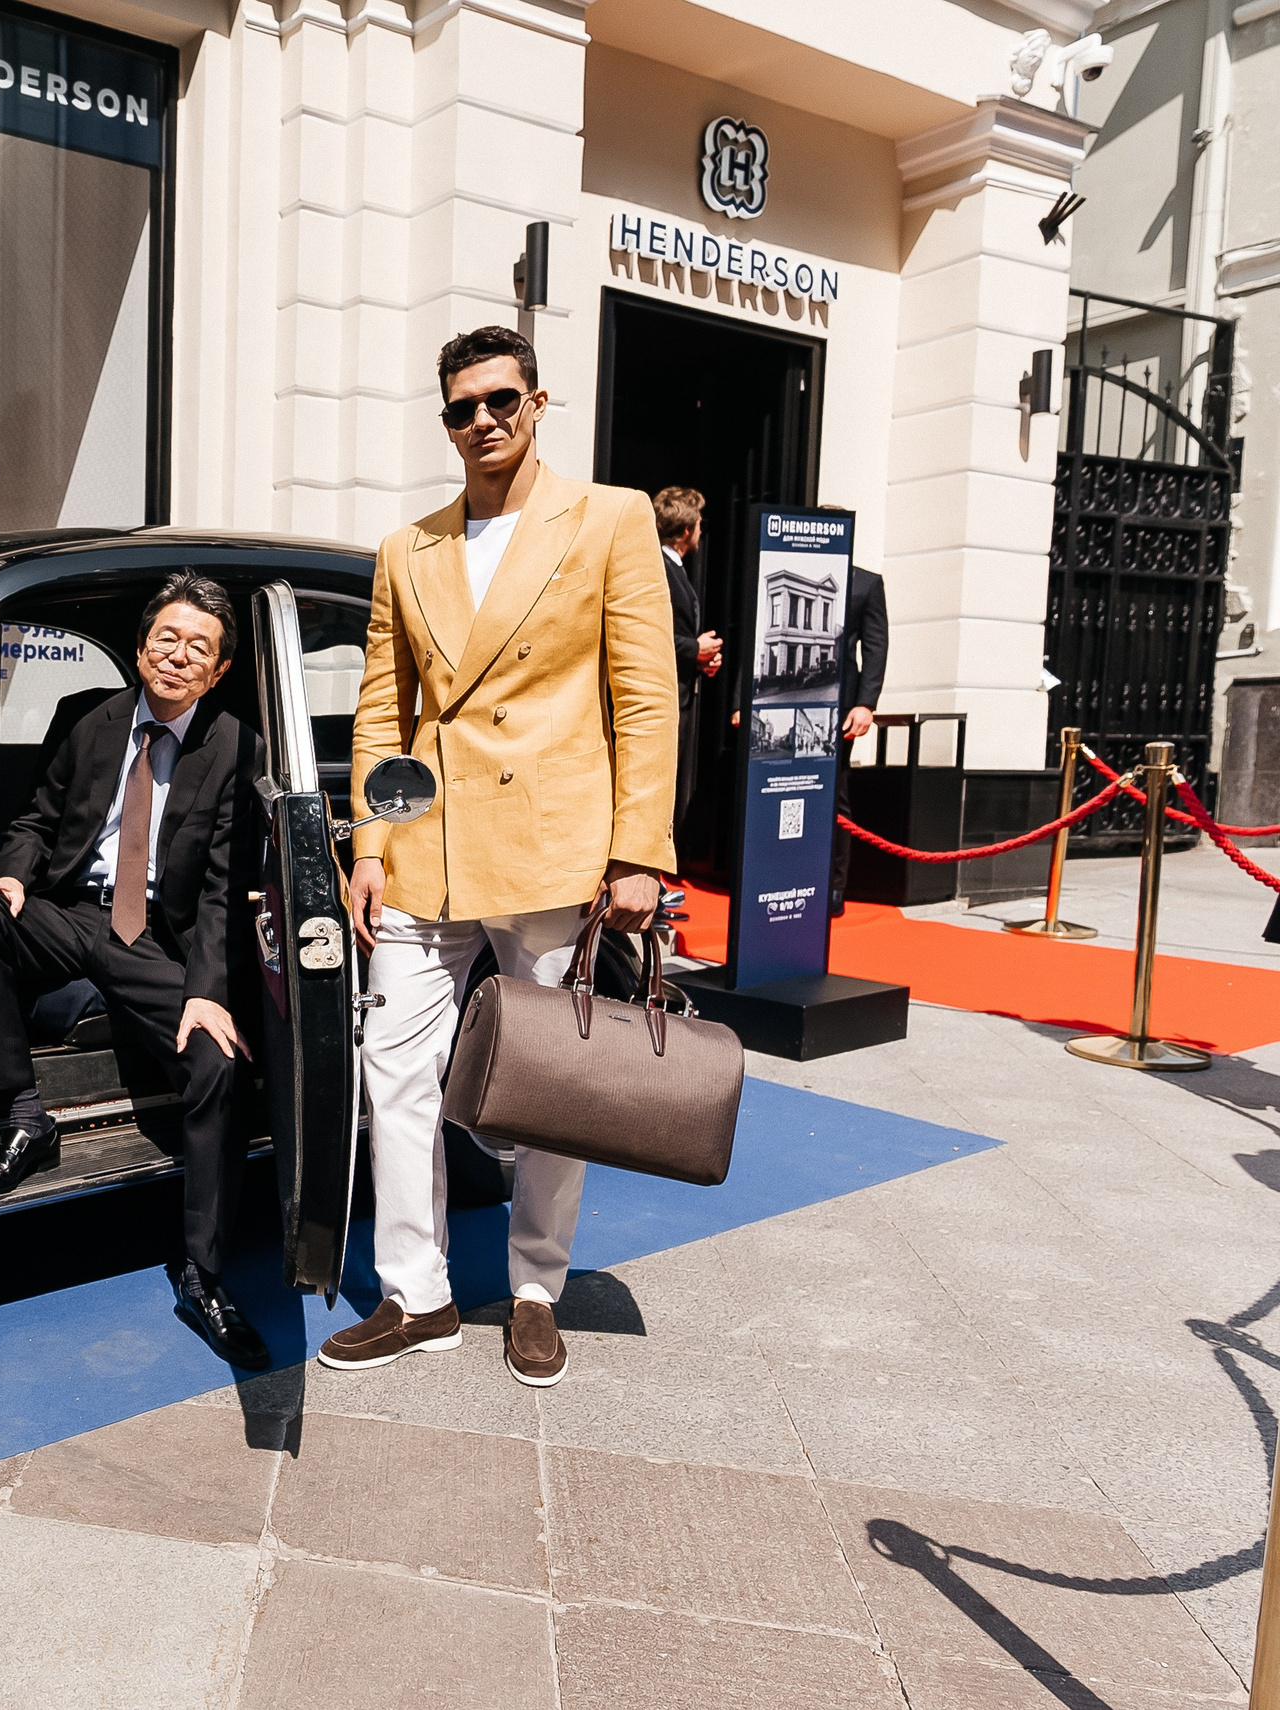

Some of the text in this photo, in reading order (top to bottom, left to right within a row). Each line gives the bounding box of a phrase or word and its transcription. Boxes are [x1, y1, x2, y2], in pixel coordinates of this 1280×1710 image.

[615, 213, 839, 301] HENDERSON
[782, 520, 845, 536] HENDERSON
[1, 643, 84, 663] меркам!
[758, 887, 816, 903] КУЗНЕЦКИЙ МОСТ
